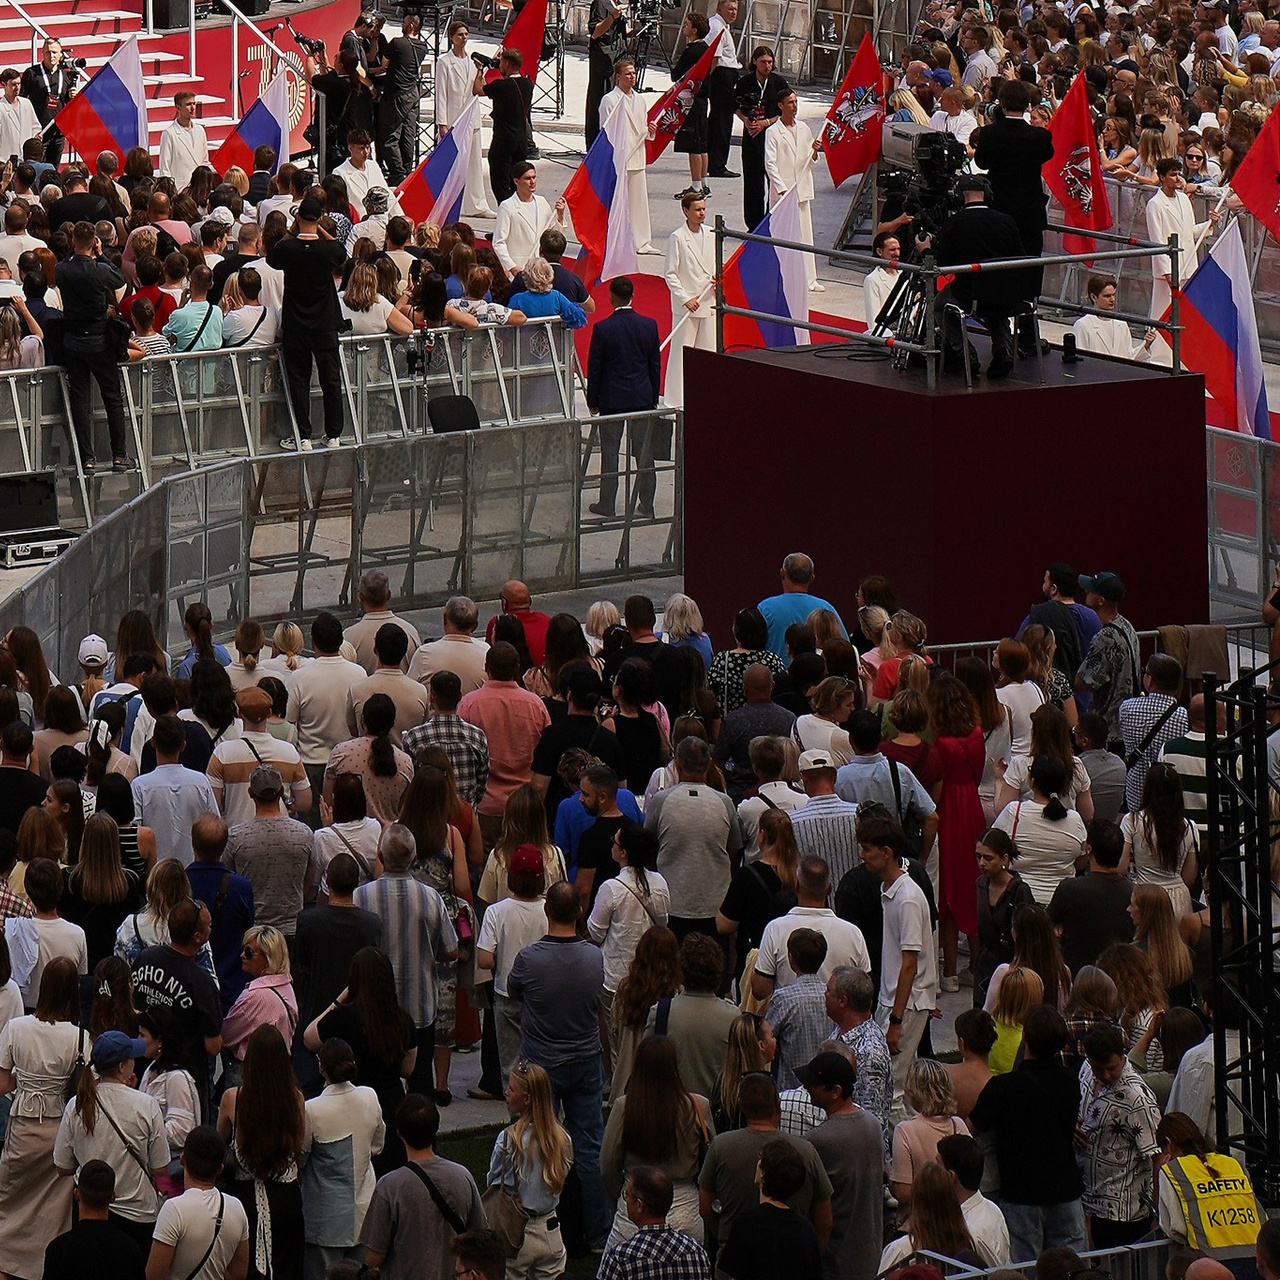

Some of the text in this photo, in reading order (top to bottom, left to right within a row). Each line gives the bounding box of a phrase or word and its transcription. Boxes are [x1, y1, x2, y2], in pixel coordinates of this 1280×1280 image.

[138, 984, 174, 1007] ATHLETICS
[165, 976, 193, 1009] NYC
[1196, 1178, 1246, 1195] SAFETY
[1207, 1208, 1256, 1228] K1258
